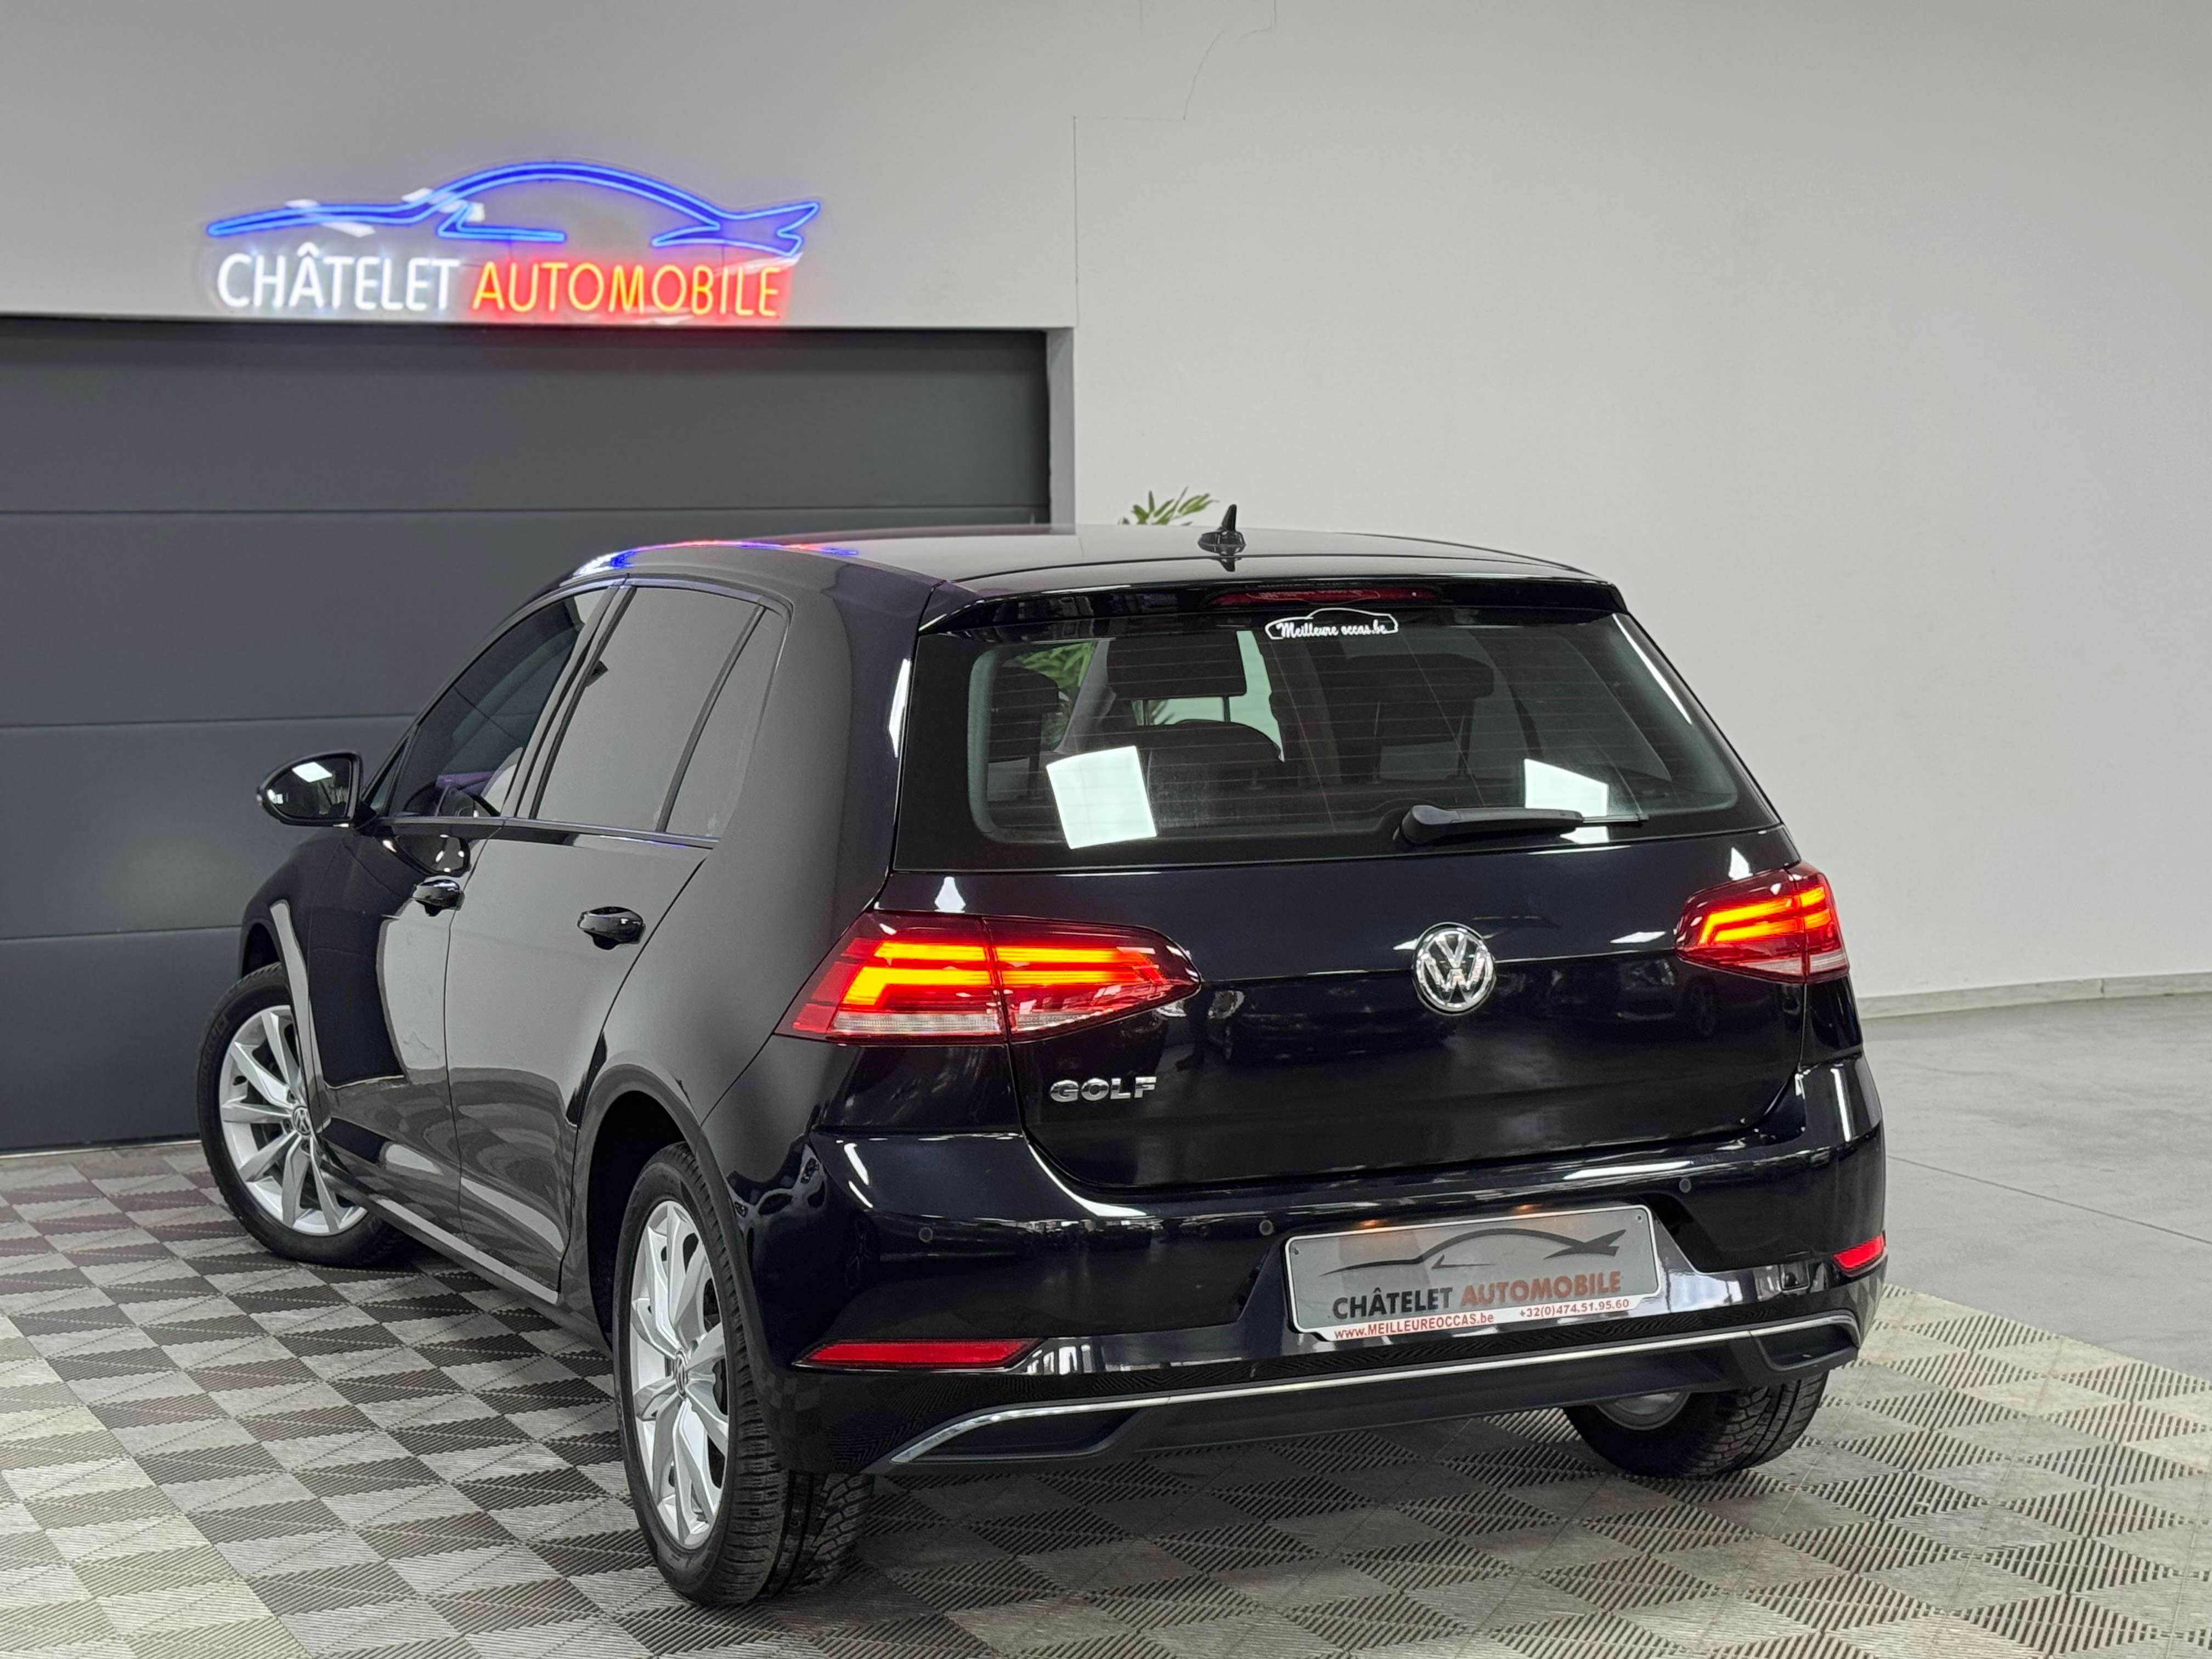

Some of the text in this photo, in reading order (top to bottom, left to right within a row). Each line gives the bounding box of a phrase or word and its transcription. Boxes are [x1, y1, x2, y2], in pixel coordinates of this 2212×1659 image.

[216, 242, 780, 317] CHÂTELET AUTOMOBILE
[1050, 1076, 1157, 1103] GOLF
[1333, 1271, 1622, 1319] CHÂTELET AUTOMOBILE
[1334, 1299, 1629, 1339] www.MEILLEUREOCCAS.be +32(0)474.51.95.60
